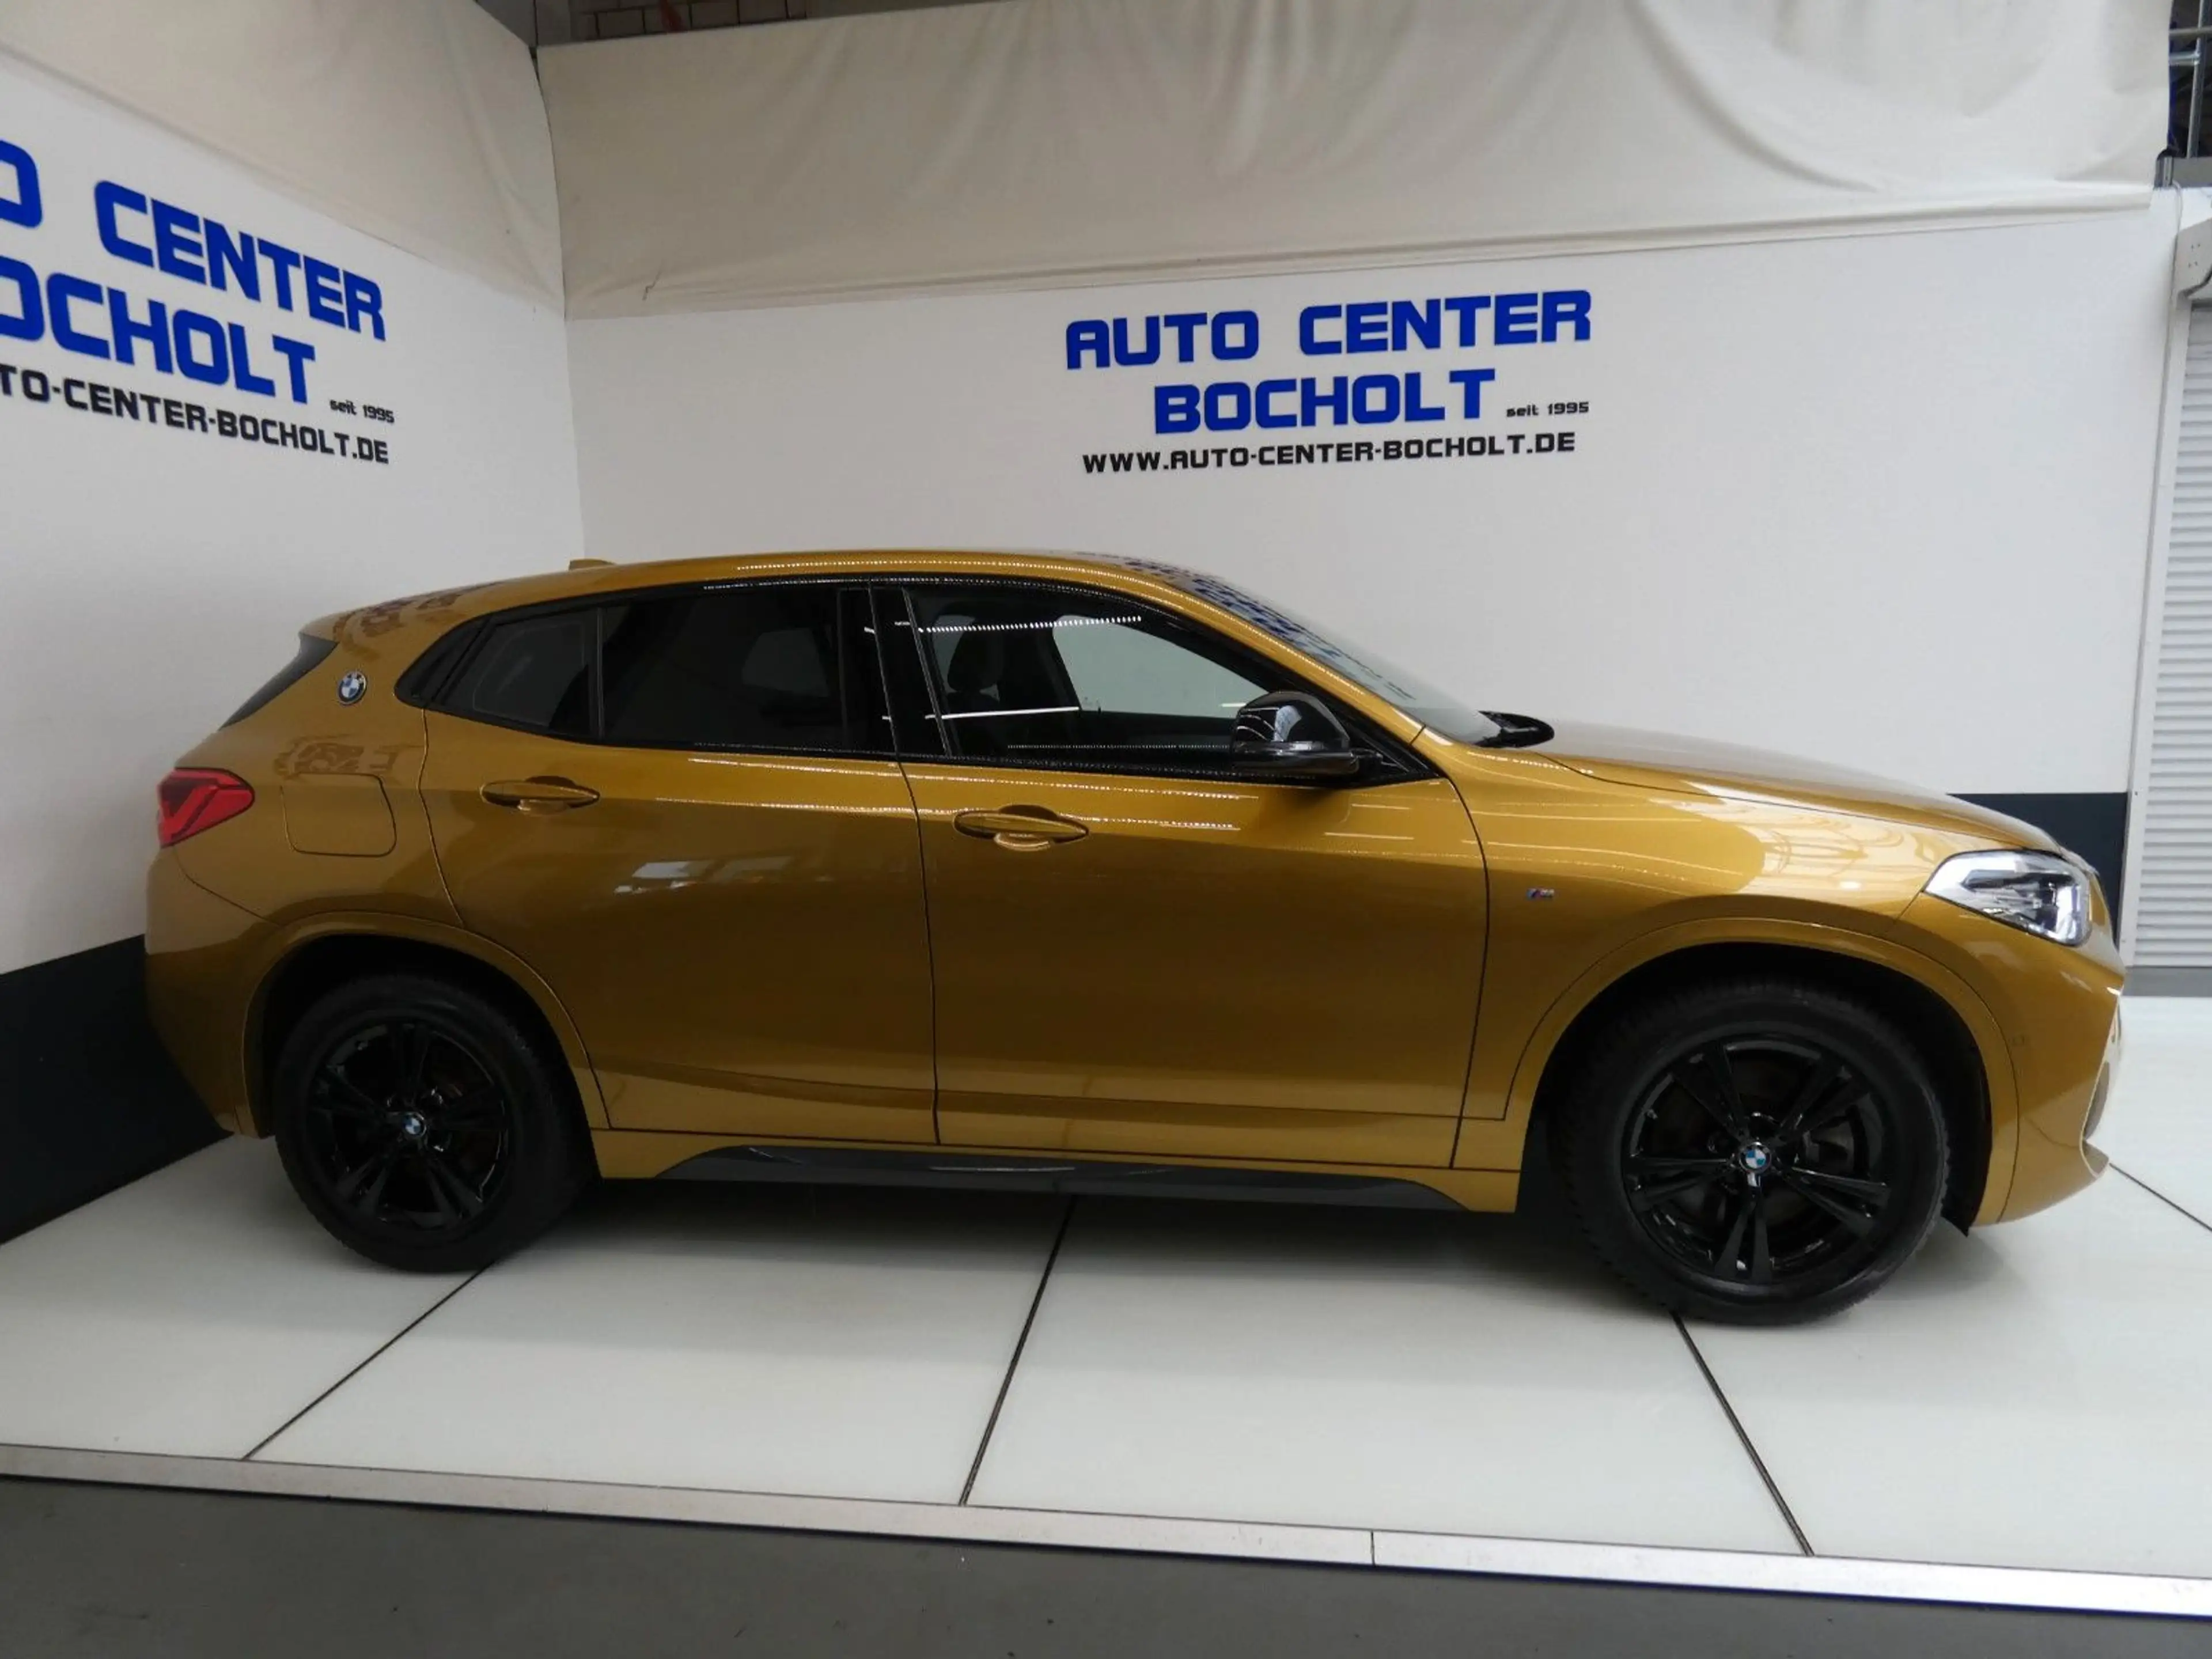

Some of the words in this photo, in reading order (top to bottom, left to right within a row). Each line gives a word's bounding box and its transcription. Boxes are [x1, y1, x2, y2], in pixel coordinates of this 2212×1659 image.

[94, 181, 386, 342] CENTER
[1067, 310, 1259, 369] AUTO
[1300, 290, 1591, 355] CENTER
[328, 399, 358, 415] seit
[363, 404, 395, 424] 1995
[1155, 369, 1496, 434] BOCHOLT
[1506, 404, 1539, 418] seit
[1547, 401, 1589, 415] 1995
[1082, 432, 1575, 475] WWW.AUTO-CENTER-BOCHOLT.DE
